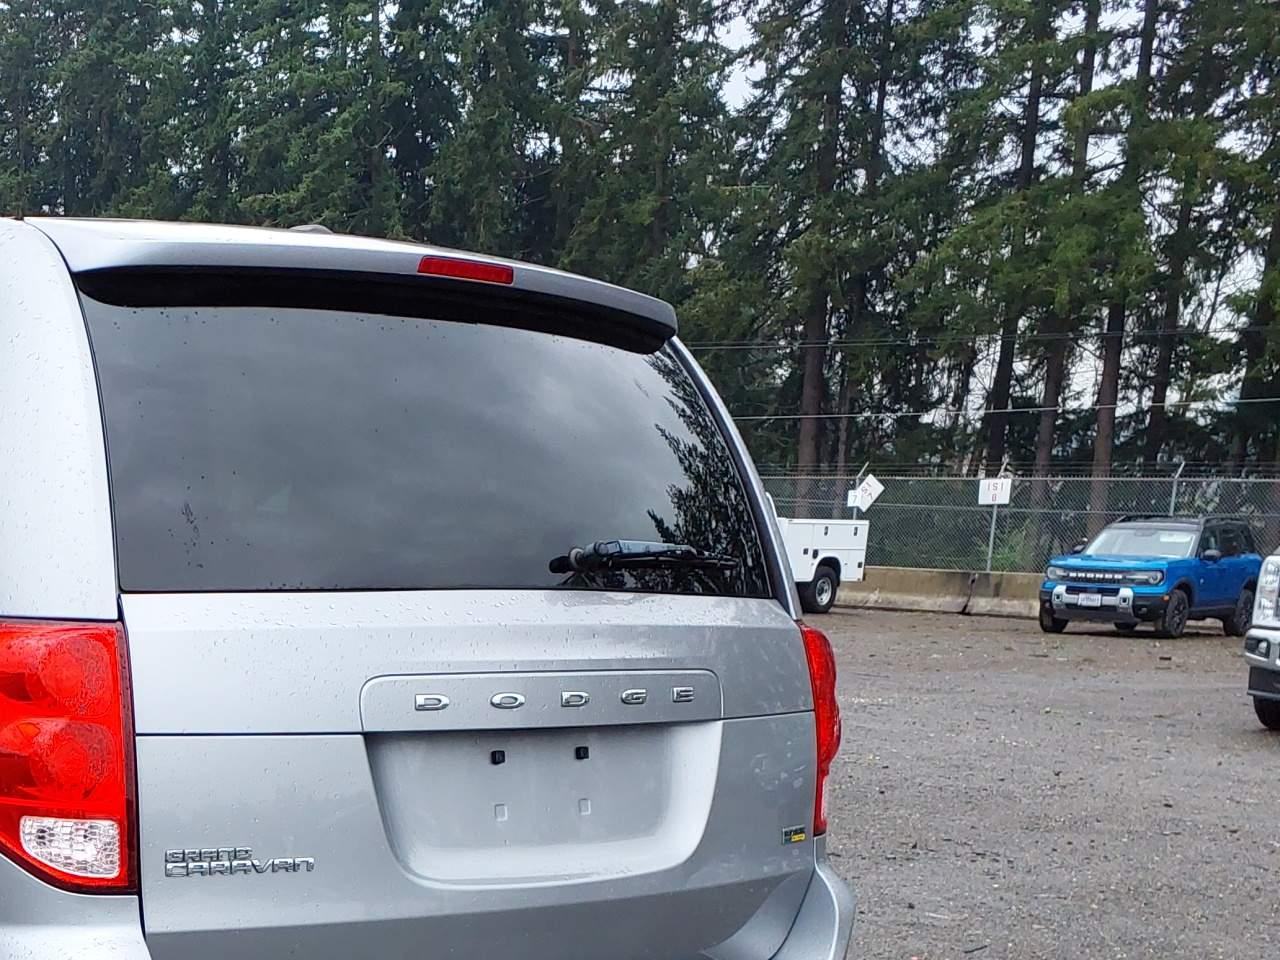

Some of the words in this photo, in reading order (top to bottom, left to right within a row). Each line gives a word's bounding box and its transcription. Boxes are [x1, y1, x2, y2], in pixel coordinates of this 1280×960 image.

[414, 686, 696, 711] DODGE
[165, 847, 253, 862] GRAND
[165, 857, 315, 877] CARAVAN
